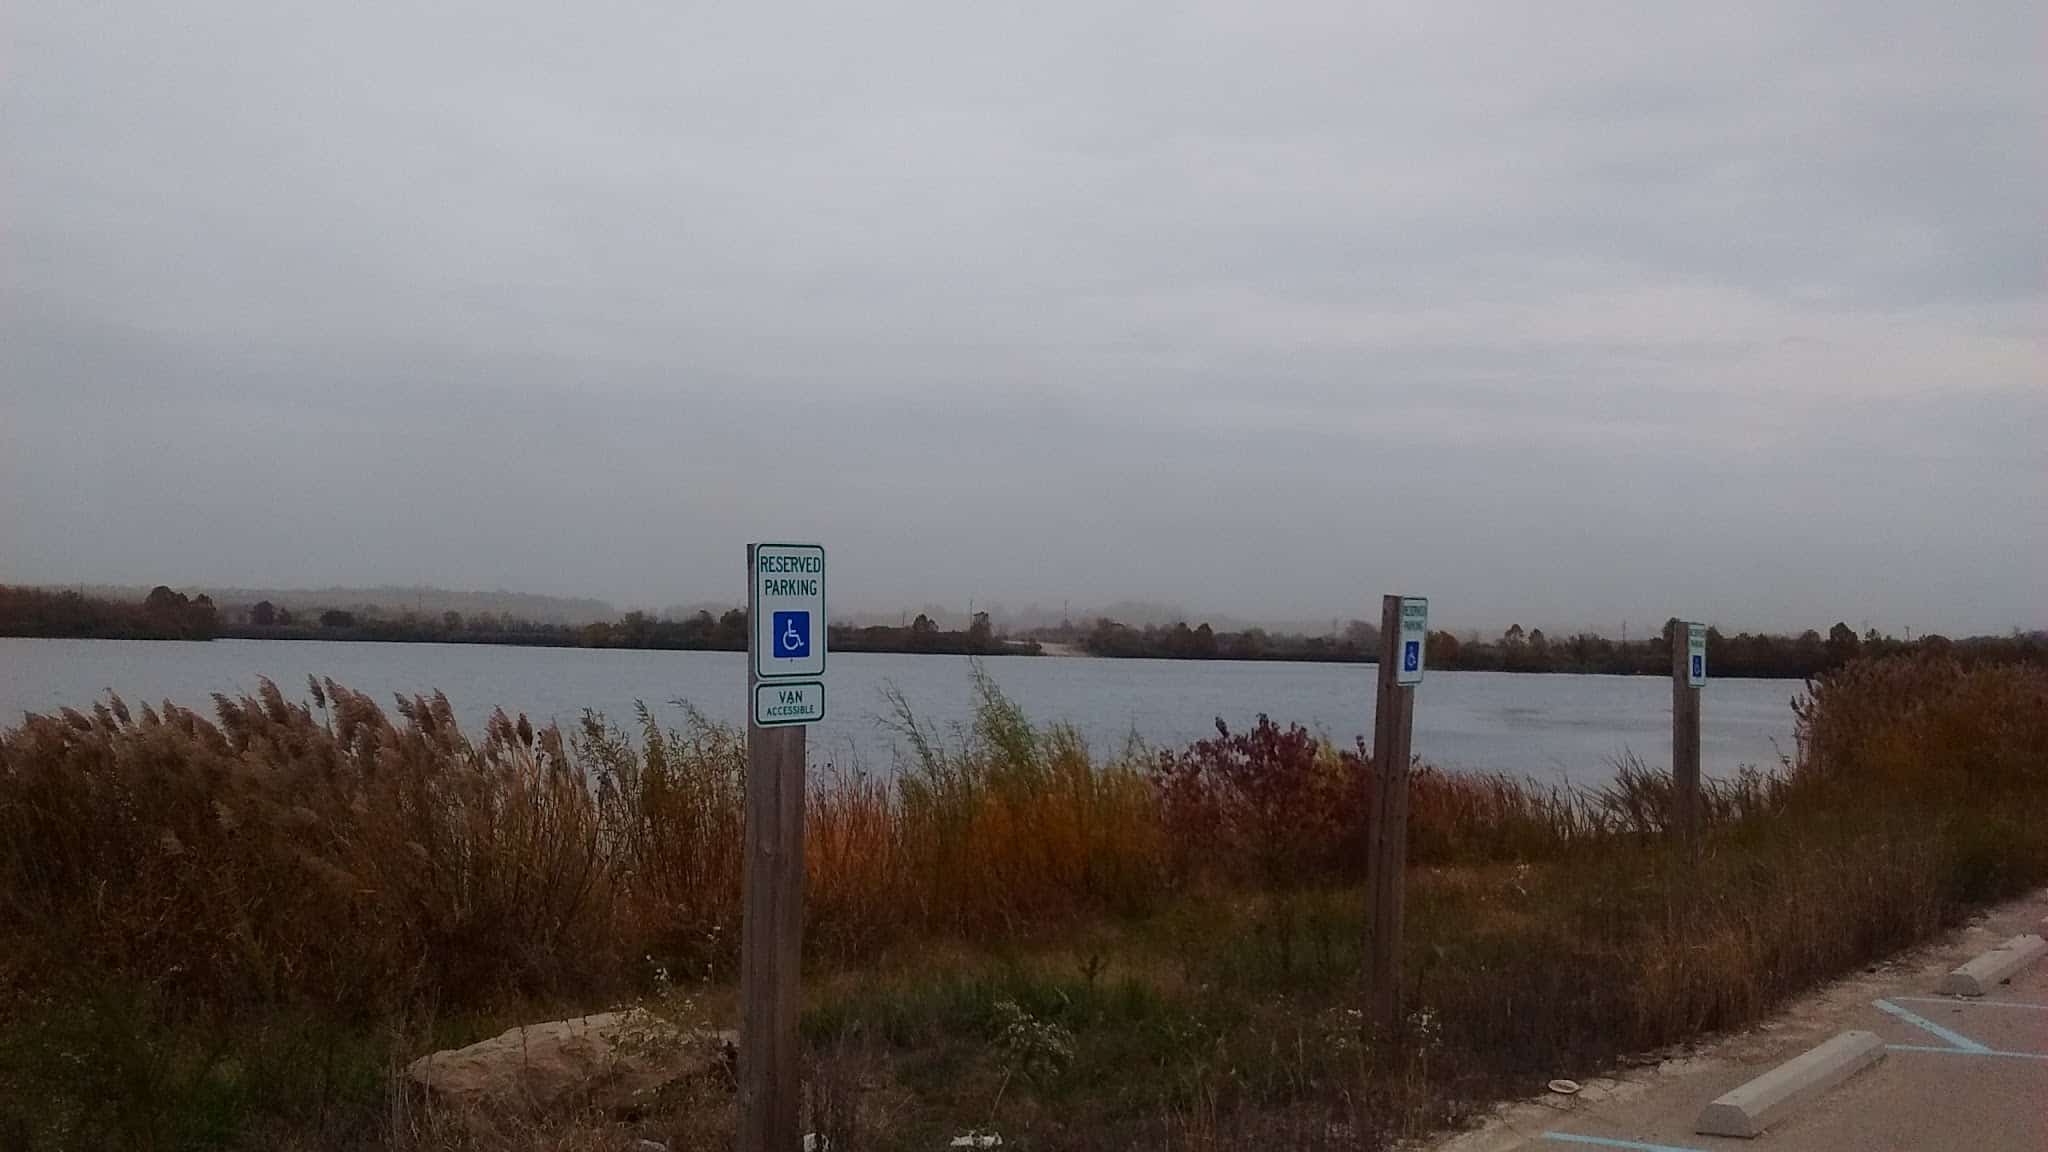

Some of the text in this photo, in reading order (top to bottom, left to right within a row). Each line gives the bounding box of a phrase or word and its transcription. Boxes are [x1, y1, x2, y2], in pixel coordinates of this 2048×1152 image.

[761, 556, 820, 573] RESERVED
[765, 580, 817, 596] PARKING
[779, 691, 802, 703] VAN
[767, 704, 814, 716] ACCESSIBLE
